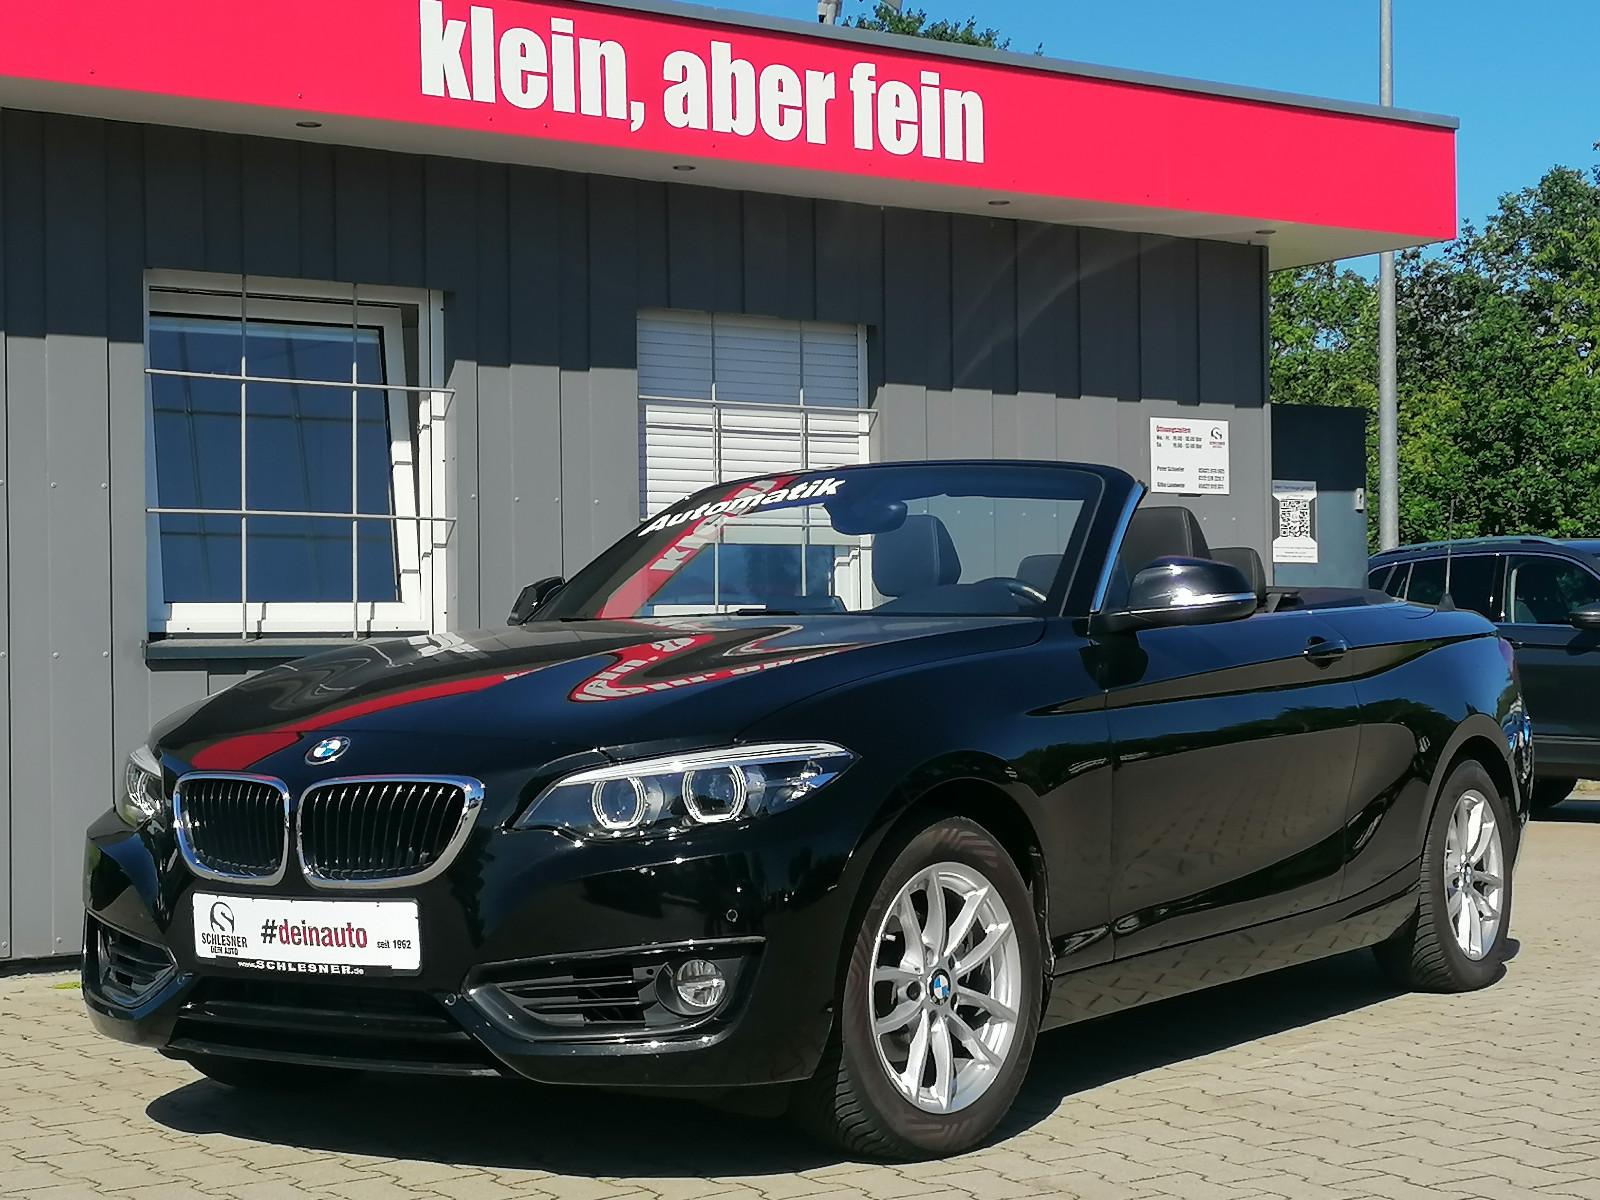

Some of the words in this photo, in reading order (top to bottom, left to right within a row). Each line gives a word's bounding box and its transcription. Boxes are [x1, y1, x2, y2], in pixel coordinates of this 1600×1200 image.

[420, 0, 645, 132] klein,
[663, 41, 836, 145] aber
[850, 62, 985, 164] fein
[638, 477, 846, 537] Automatik
[201, 932, 248, 949] SCHLESNER
[261, 918, 368, 949] #deinauto
[376, 939, 390, 949] seit
